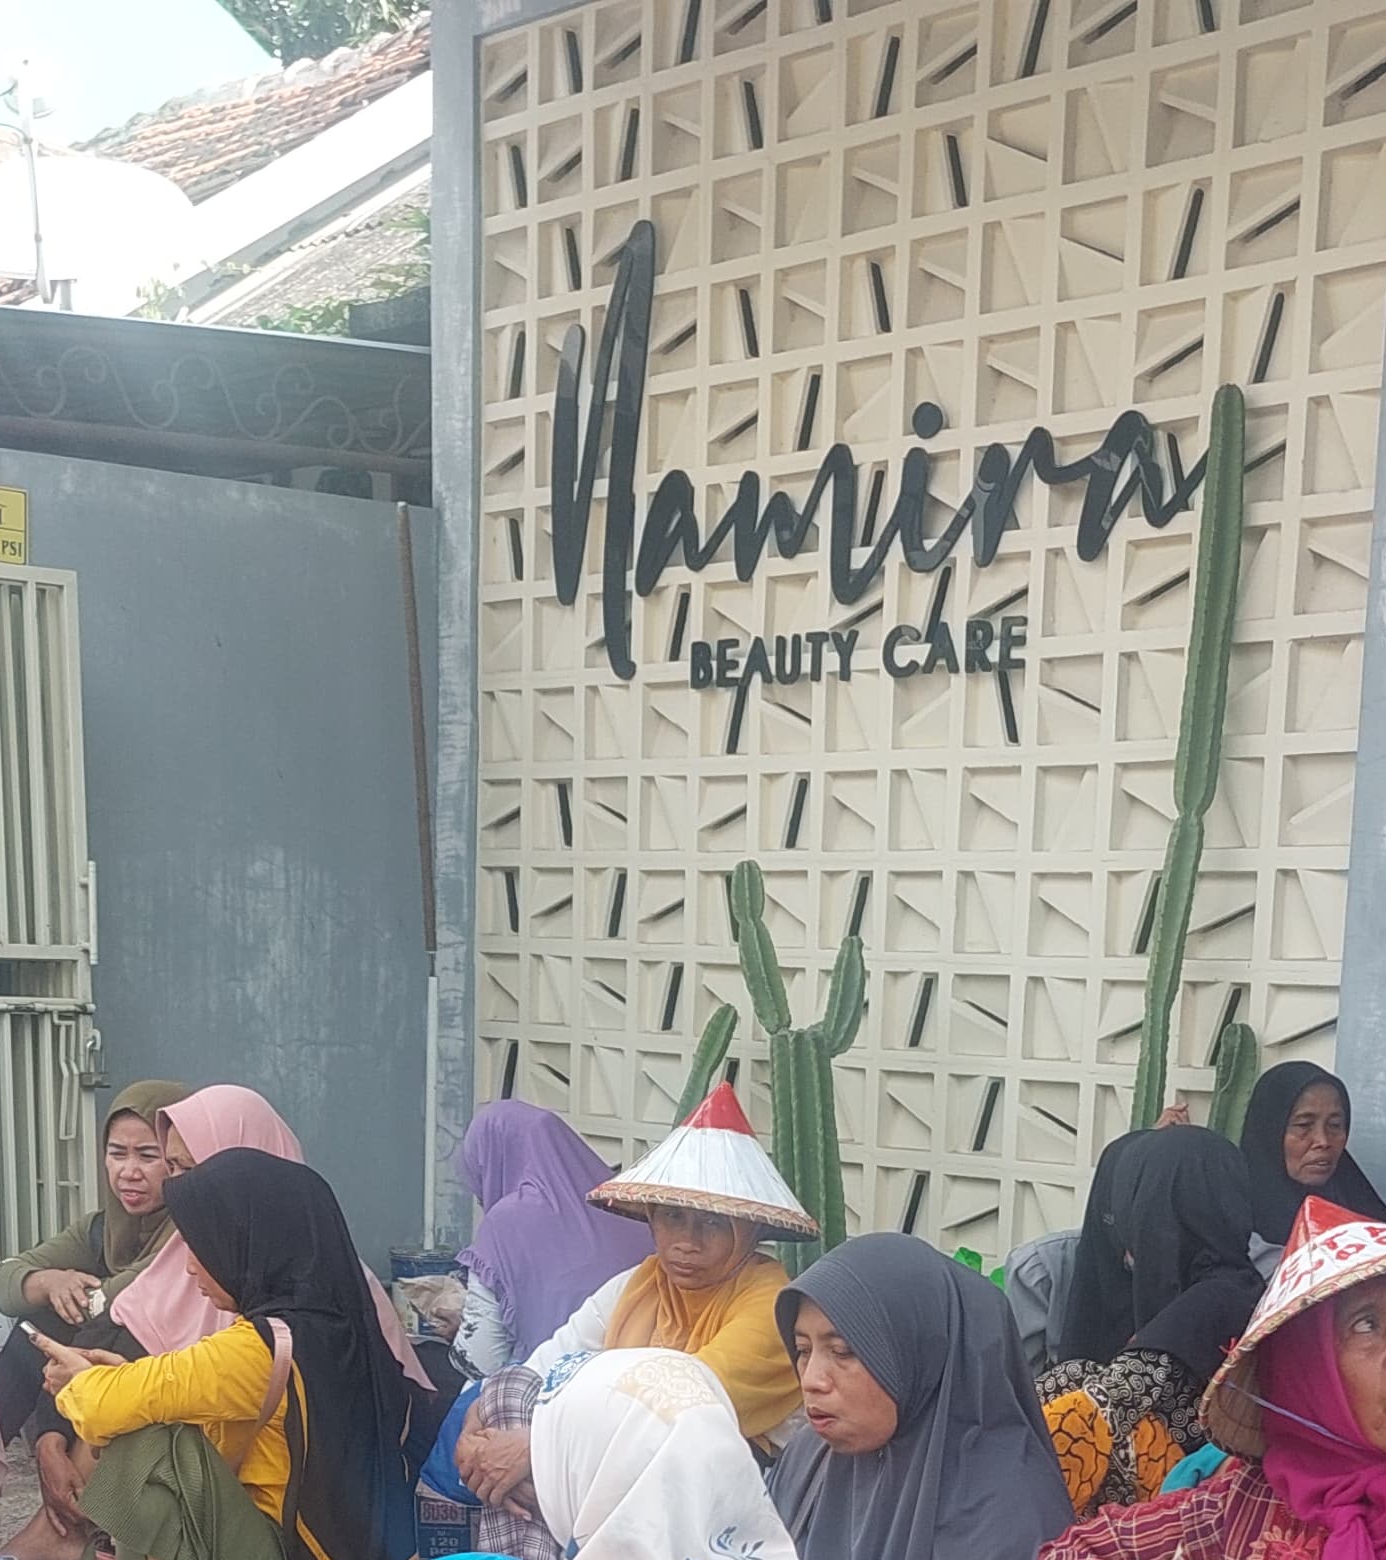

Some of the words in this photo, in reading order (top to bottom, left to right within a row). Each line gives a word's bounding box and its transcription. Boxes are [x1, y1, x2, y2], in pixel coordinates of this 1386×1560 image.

[552, 219, 1211, 681] Namira
[0, 539, 23, 558] PSI
[690, 627, 859, 691] BEAUTY
[882, 615, 1029, 680] CARE
